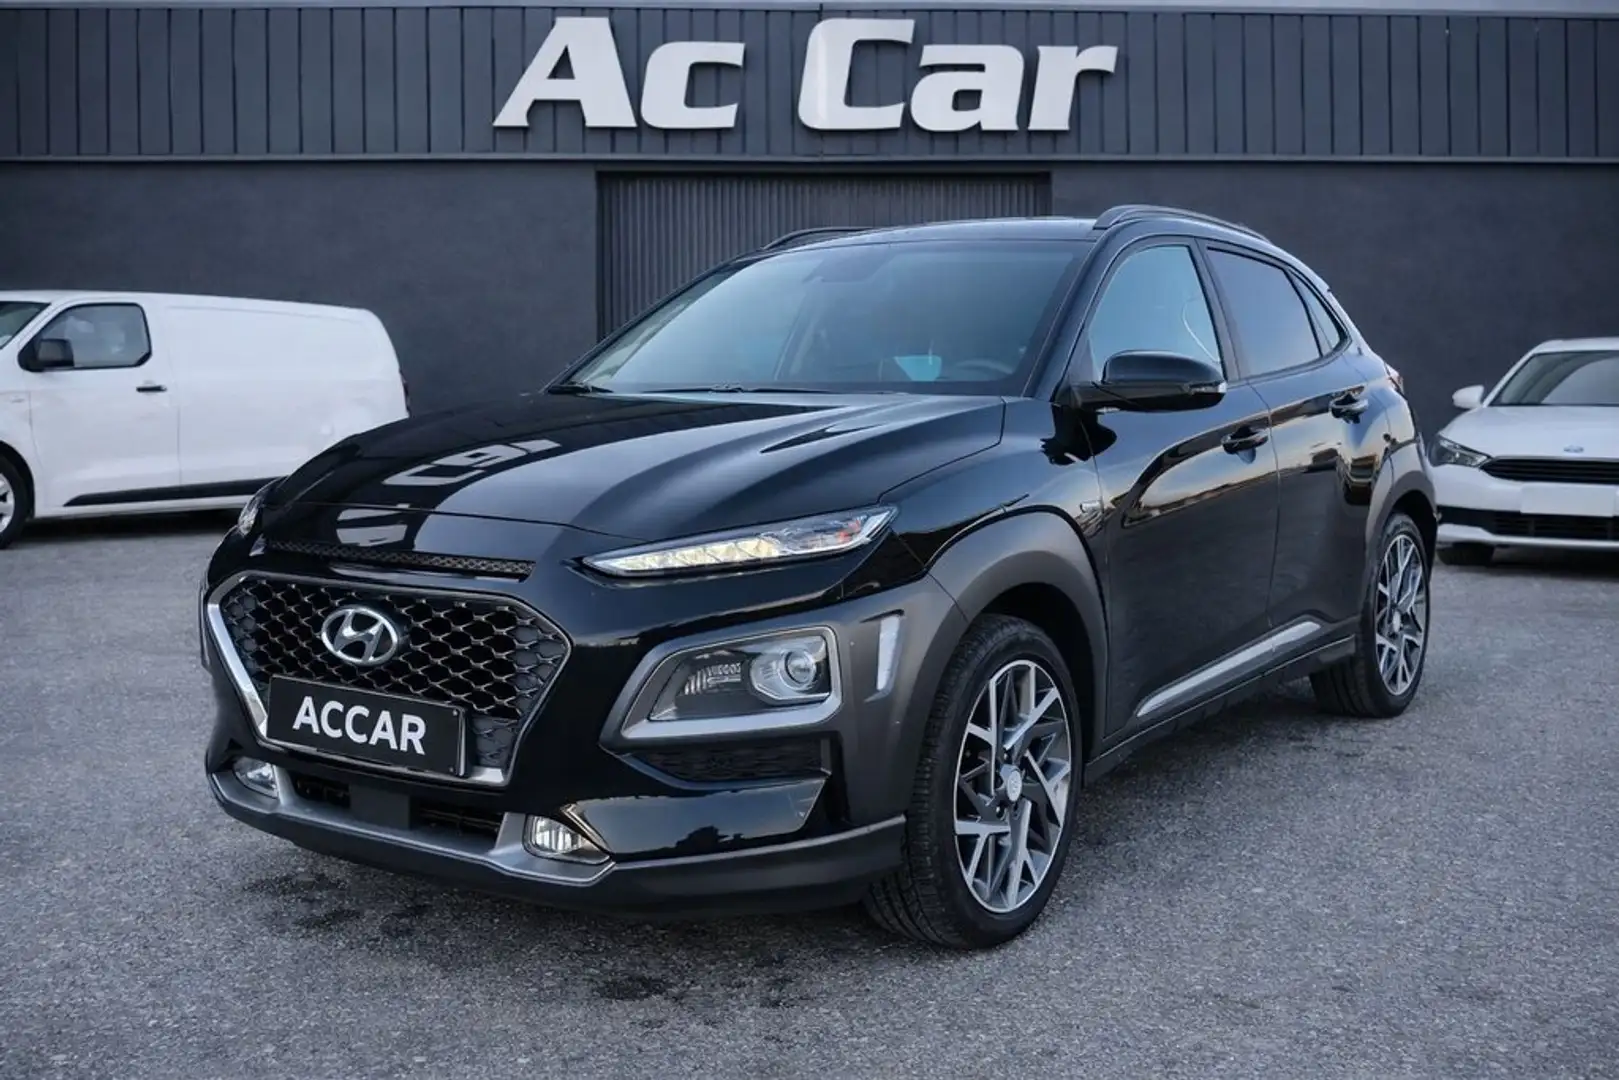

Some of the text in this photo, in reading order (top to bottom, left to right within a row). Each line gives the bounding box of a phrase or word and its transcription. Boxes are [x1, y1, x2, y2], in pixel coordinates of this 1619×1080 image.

[493, 16, 1119, 132] Ac Car
[292, 695, 426, 754] ACCAR
